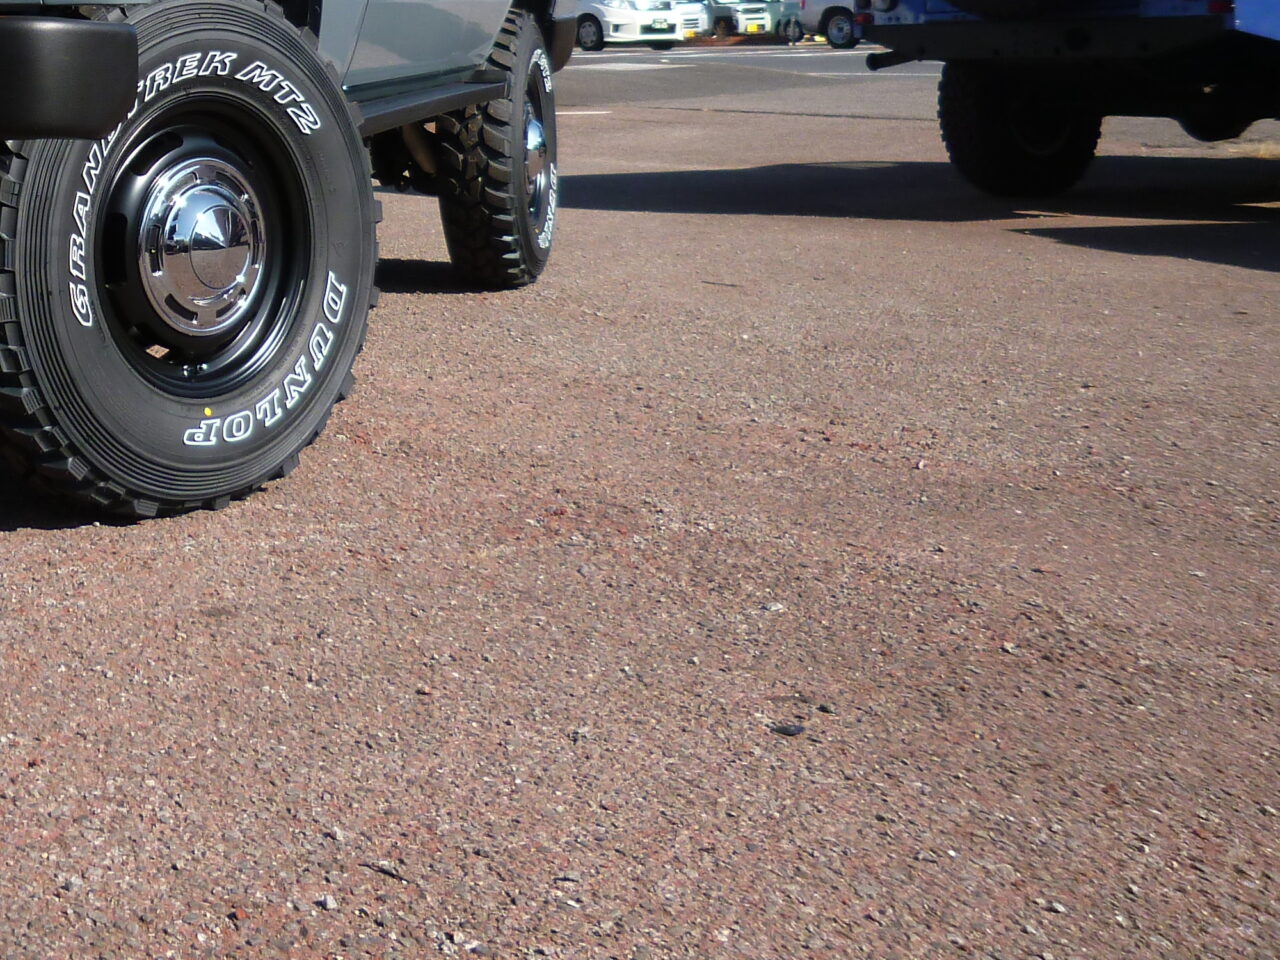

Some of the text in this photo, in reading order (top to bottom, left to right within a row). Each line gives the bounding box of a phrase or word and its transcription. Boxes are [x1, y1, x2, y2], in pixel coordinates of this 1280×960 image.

[68, 51, 322, 327] GRANREK MT2
[183, 270, 348, 446] DUNLOP
